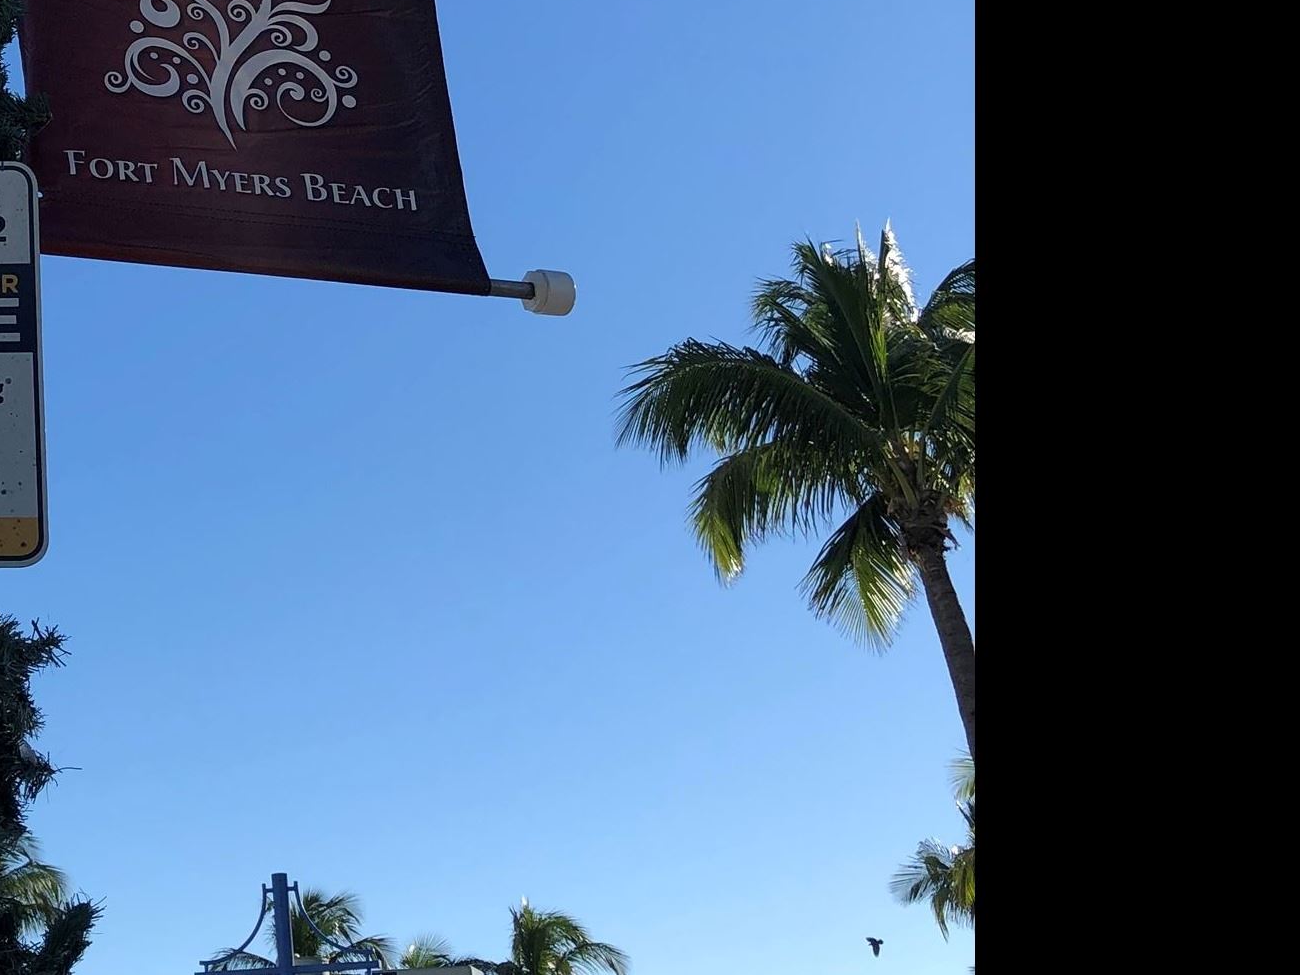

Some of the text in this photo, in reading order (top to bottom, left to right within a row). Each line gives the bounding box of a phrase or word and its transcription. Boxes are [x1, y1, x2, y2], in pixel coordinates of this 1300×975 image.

[63, 150, 418, 211] FORT MYERS BEACH
